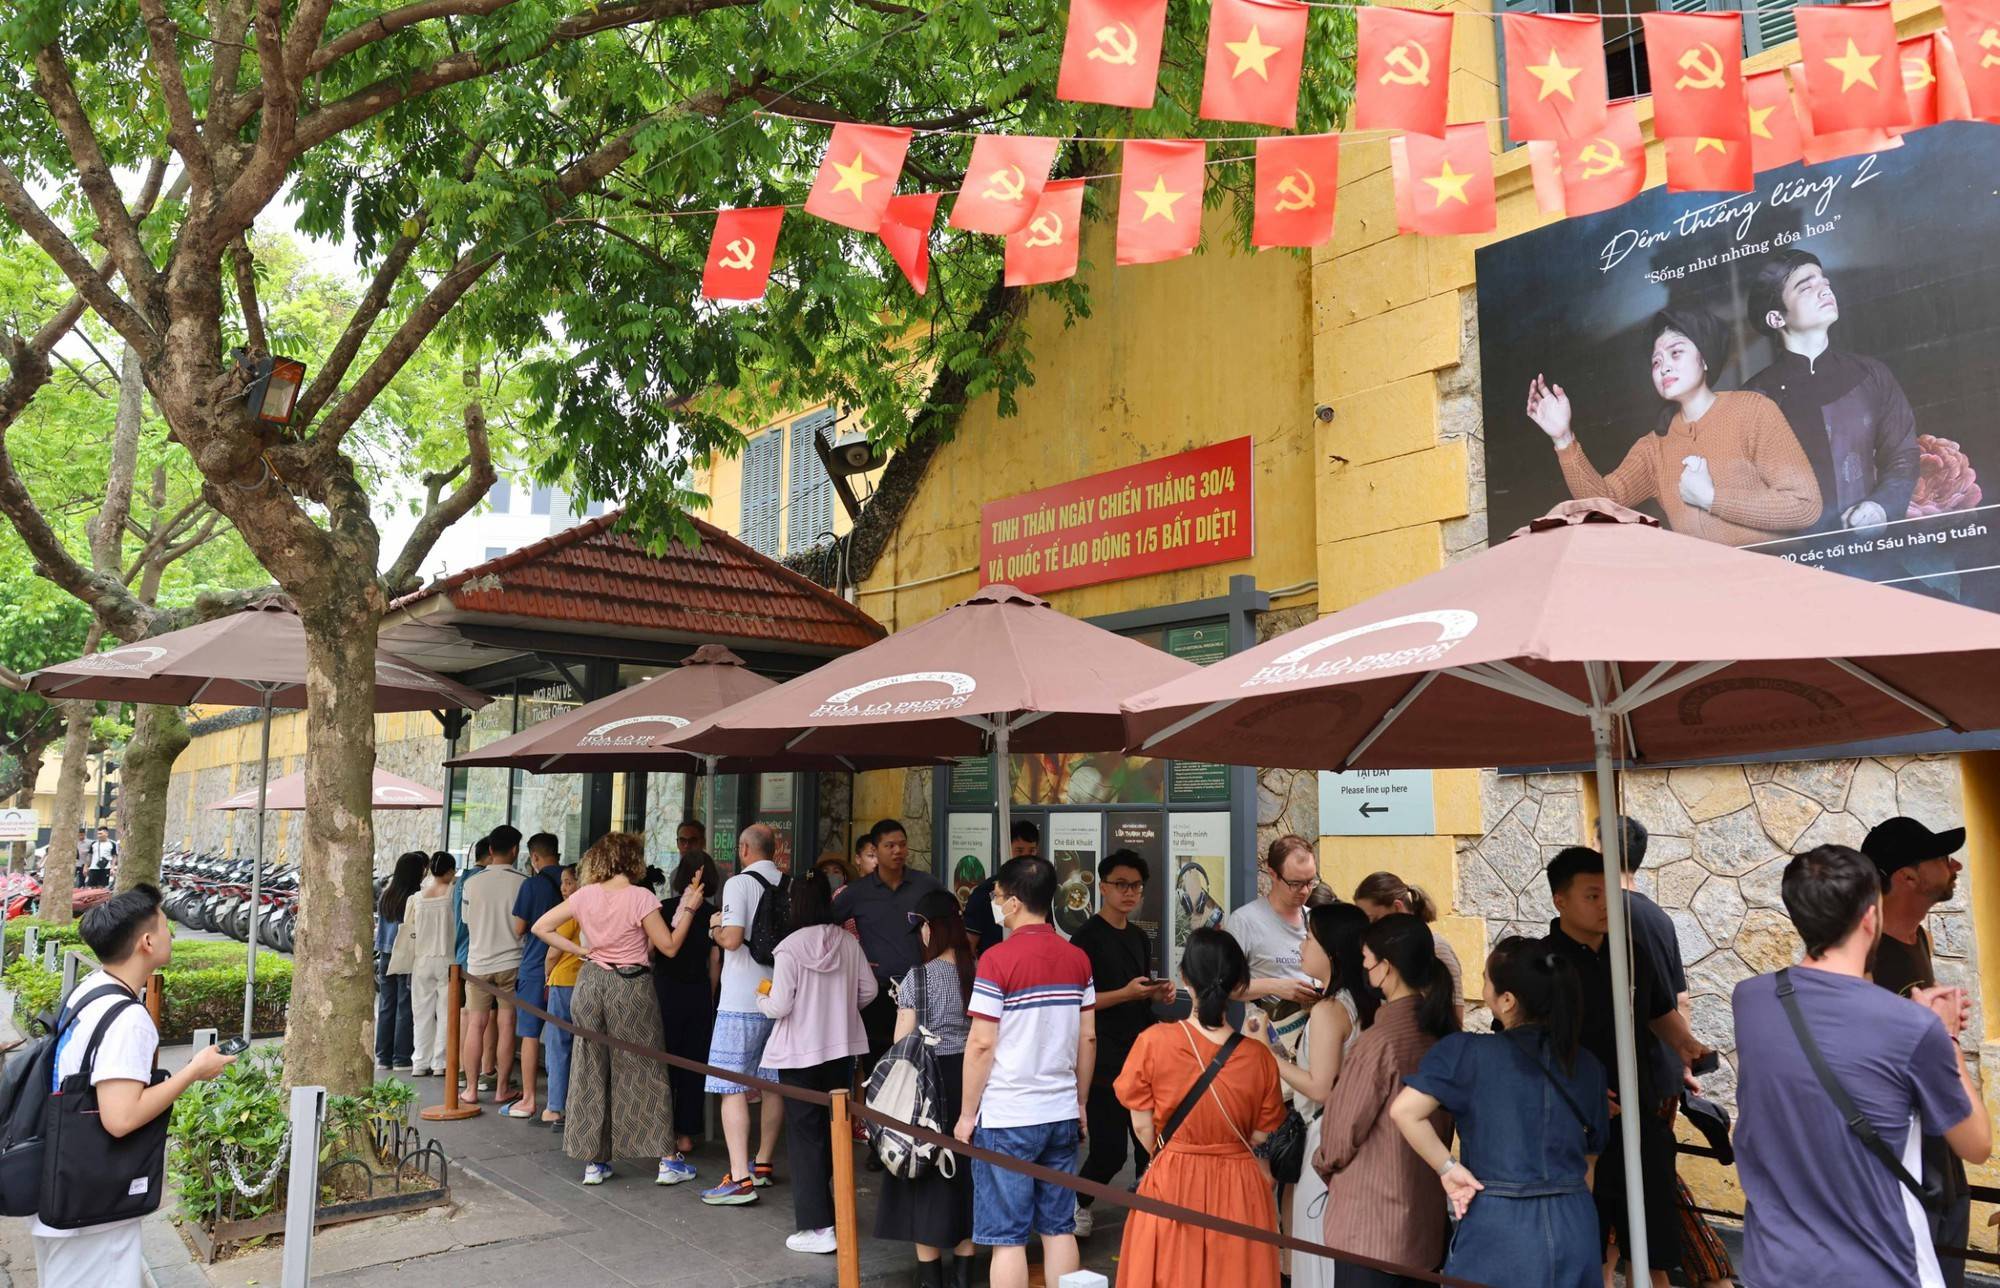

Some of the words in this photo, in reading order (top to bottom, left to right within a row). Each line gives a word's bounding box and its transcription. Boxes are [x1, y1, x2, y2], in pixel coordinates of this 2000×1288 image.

[1600, 229, 1671, 274] Đêm
[1851, 154, 1883, 188] 2
[1688, 253, 1718, 272] như
[1721, 240, 1770, 264] những
[1774, 229, 1802, 247] đóa
[991, 516, 1019, 545] TINH
[1022, 502, 1054, 538] THẦN
[1059, 496, 1095, 530] NGÀY
[1098, 481, 1142, 521] CHIẾN
[1145, 471, 1195, 510] THẮNG
[1199, 466, 1235, 498] 30/4
[988, 554, 1004, 583] VÀ
[1007, 543, 1041, 580] QUỐC
[1044, 537, 1061, 572] TẾ
[1063, 541, 1087, 569] LAO
[1091, 532, 1130, 567] ĐỘNG
[1135, 526, 1157, 554] 1/5
[1162, 511, 1190, 550] BẤT
[1196, 508, 1236, 546] DIỆT!
[1800, 548, 1824, 562] các
[1827, 543, 1845, 558] tối
[1848, 540, 1874, 554] thứ
[1876, 535, 1904, 550] Sáu
[1908, 529, 1946, 546] hàng
[1950, 523, 1987, 539] tuần
[532, 706, 551, 721] Ticket
[551, 703, 571, 717] Office
[896, 694, 972, 709] PRISON
[1341, 785, 1364, 795] Please
[1366, 785, 1379, 794] line
[1380, 786, 1390, 796] up
[1391, 784, 1408, 793] here
